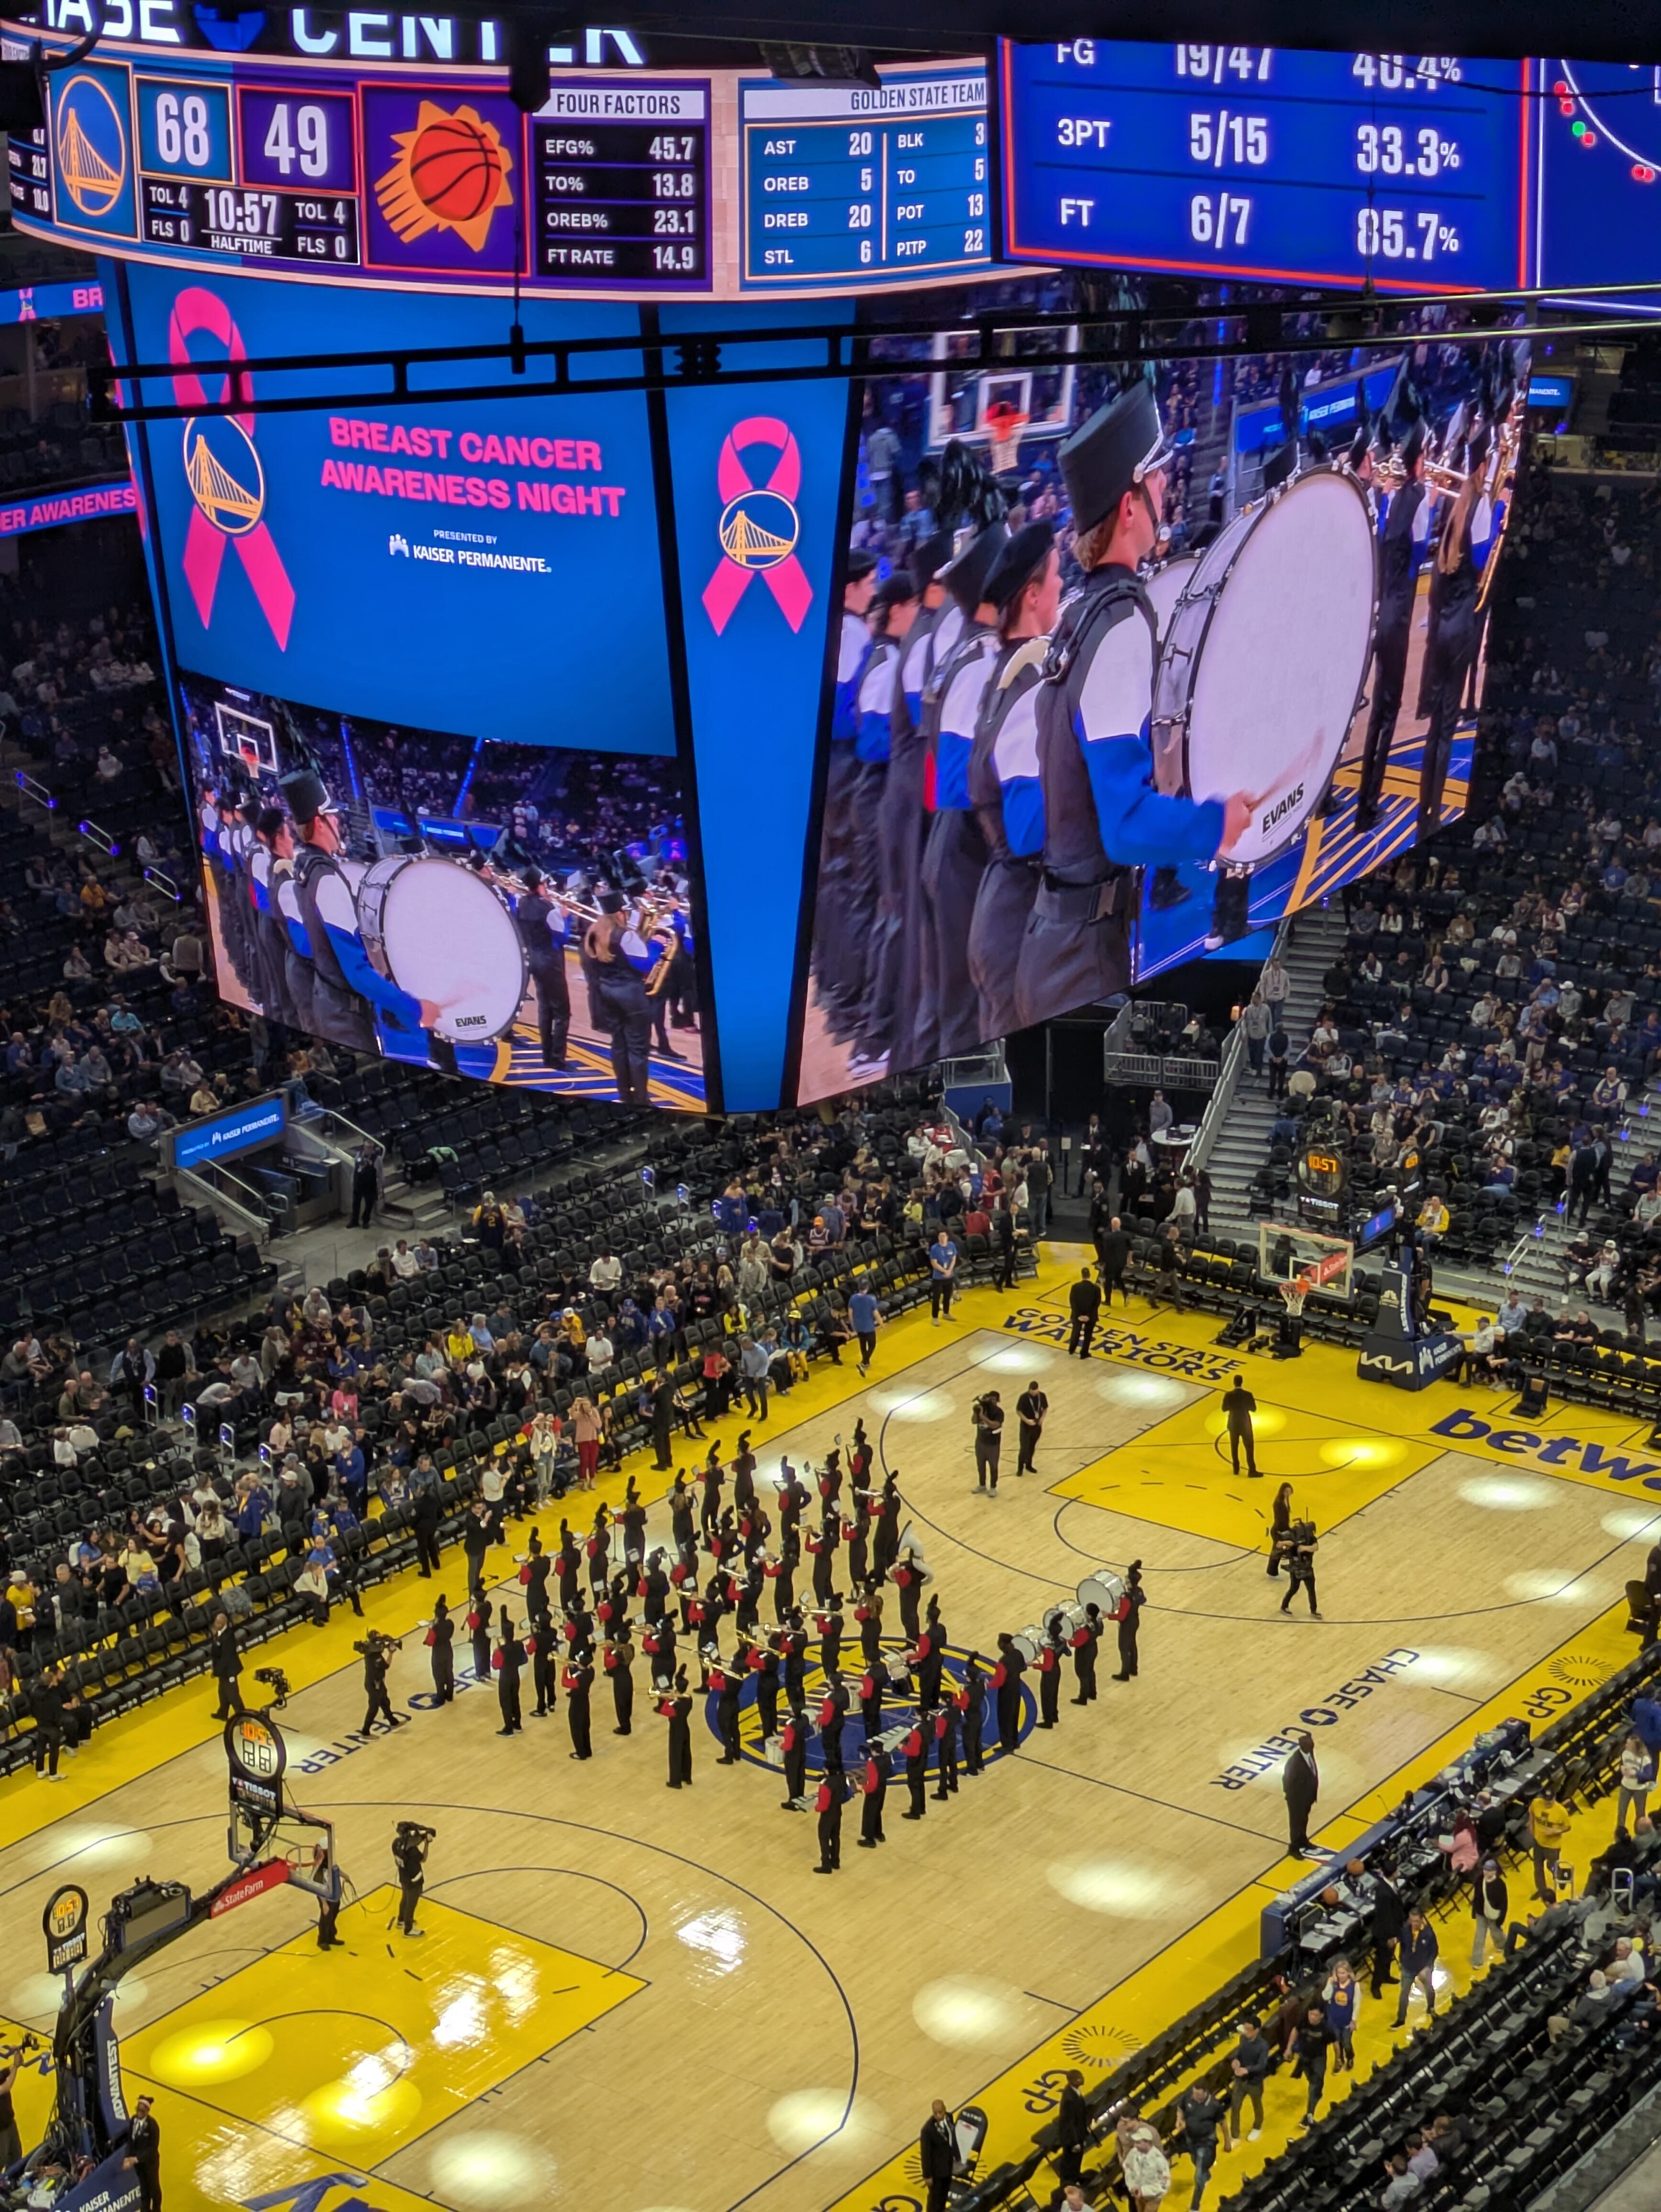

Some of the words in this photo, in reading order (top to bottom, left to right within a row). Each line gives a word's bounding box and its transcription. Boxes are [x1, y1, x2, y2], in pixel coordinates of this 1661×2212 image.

[44, 0, 181, 42] ASE
[557, 94, 599, 113] FOUR
[604, 94, 680, 115] FACTORS
[851, 89, 906, 111] GOLDEN
[909, 86, 949, 107] STATE
[952, 82, 985, 103] TEAM
[155, 92, 209, 166] 68
[264, 103, 328, 177] 49
[975, 122, 984, 145] 3
[1058, 118, 1110, 147] 3PT
[1190, 110, 1267, 167] 5/15
[545, 139, 594, 155] EFG%
[649, 136, 693, 160] 45.7
[764, 140, 796, 155] AST
[849, 132, 871, 156] 20
[898, 134, 923, 148] BLK
[1356, 124, 1460, 176] 33.3%
[861, 167, 872, 191] 5
[898, 170, 915, 184] TO
[975, 158, 984, 181] 5
[545, 176, 584, 191] TO%
[653, 173, 693, 197] 13.8
[764, 177, 809, 191] OREB
[150, 186, 174, 204] TOL
[178, 186, 188, 208] 4
[967, 194, 983, 217] 13
[204, 189, 277, 234] 10:57
[295, 201, 326, 220] TOL
[333, 201, 345, 223] 4
[546, 212, 608, 228] OREB%
[654, 210, 694, 233] 23.1
[764, 213, 808, 227] DREB
[849, 204, 871, 228] 20
[897, 205, 924, 220] POT
[1061, 199, 1094, 226] FT
[1191, 193, 1250, 248] 6/7
[152, 220, 174, 237] FLS
[180, 221, 189, 242] 0
[964, 230, 983, 253] 22
[1357, 208, 1459, 260] 85.7%
[211, 235, 272, 254] HALFTIME
[298, 237, 325, 253] FLS
[335, 235, 345, 258] 0
[861, 240, 871, 264] 6
[897, 241, 927, 255] PITP
[548, 249, 567, 264] FT
[571, 250, 614, 265] RATE
[653, 246, 694, 270] 14.9
[764, 250, 794, 264] STL
[329, 417, 452, 459] BREAST
[459, 432, 602, 471] CANCER
[321, 459, 510, 509] AWARENESS
[518, 482, 625, 517] NIGHT
[433, 530, 484, 544] PRESENTED
[486, 535, 497, 545] BY
[413, 545, 454, 564] KAISER
[1262, 782, 1304, 834] EVANS
[455, 1015, 487, 1028] EVANS
[1308, 1154, 1338, 1173] 10:57
[1003, 1315, 1230, 1381] WARIORS
[1150, 1342, 1247, 1371] STATE
[1321, 1648, 1420, 1710] CHASE
[1208, 1726, 1312, 1790] CENTER
[244, 1781, 276, 1800] TISSOT
[107, 2039, 126, 2121] ADVANTEST
[79, 2190, 110, 2212] KAISER
